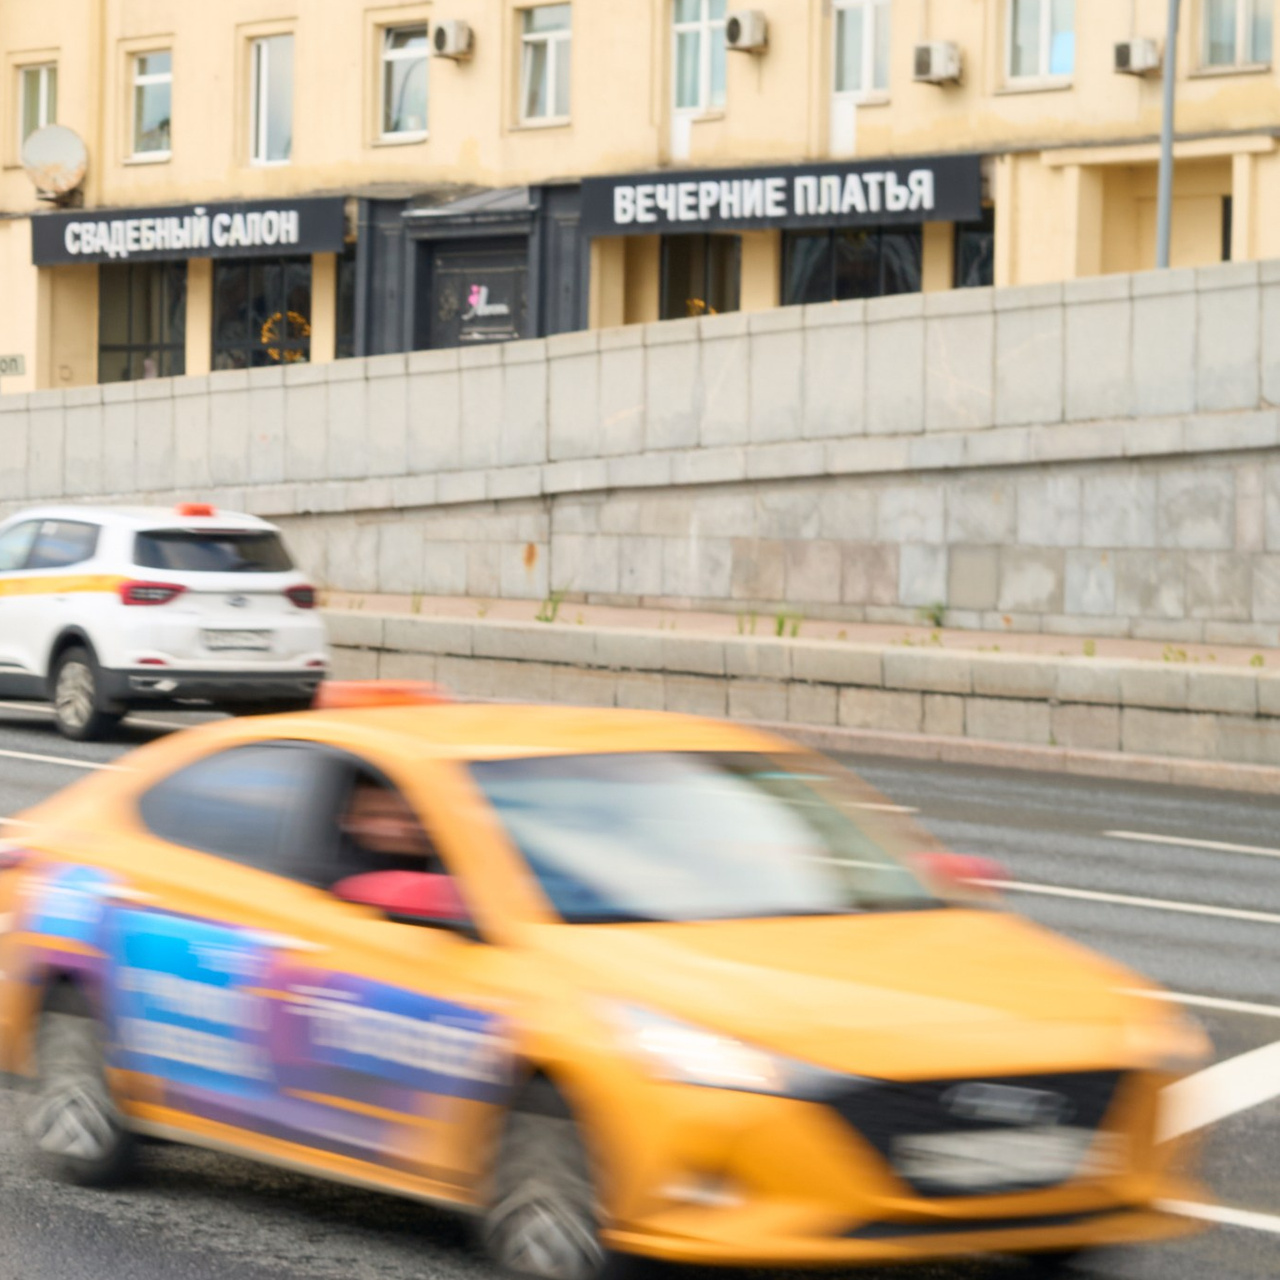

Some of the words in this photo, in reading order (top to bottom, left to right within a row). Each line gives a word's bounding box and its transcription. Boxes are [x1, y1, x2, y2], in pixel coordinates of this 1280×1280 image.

[613, 177, 788, 224] ВЕЧЕРНИЕ
[794, 169, 935, 216] ПЛАТЬЯ
[64, 206, 210, 259] СВАДЕБНЫЙ
[212, 210, 300, 248] САЛОН
